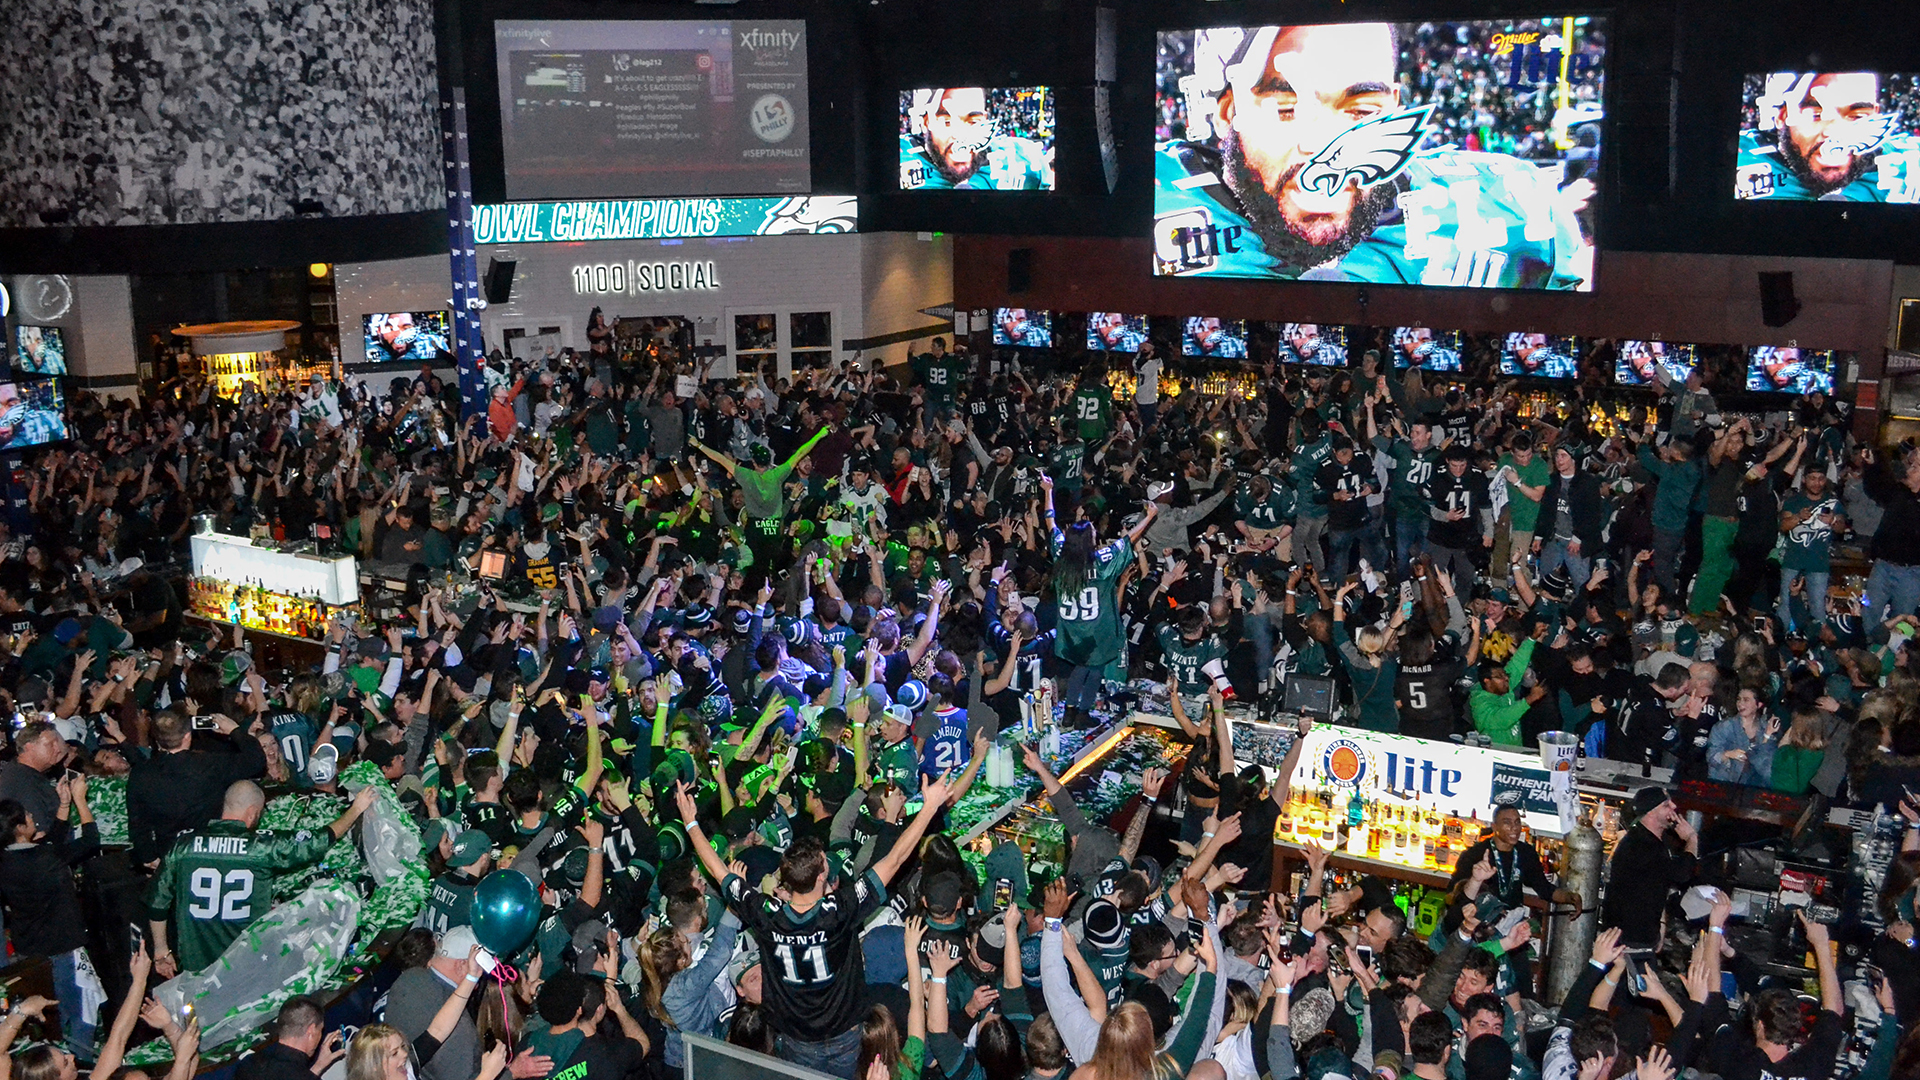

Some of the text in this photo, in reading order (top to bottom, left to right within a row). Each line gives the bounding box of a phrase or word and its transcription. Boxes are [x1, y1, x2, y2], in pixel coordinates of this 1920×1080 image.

[740, 28, 800, 50] xfinity
[1491, 32, 1540, 55] Miller
[760, 116, 788, 134] PHILLY
[549, 198, 723, 241] CHAMPIONS
[1174, 224, 1242, 269] Lite
[571, 261, 721, 295] 1100 SOCIAL
[929, 367, 947, 385] 92
[1447, 426, 1471, 447] 25
[1310, 442, 1332, 461] WENTZ
[1065, 456, 1084, 478] 20
[1406, 458, 1432, 483] 20
[1445, 490, 1471, 519] 11
[763, 527, 777, 535] FLY
[526, 565, 557, 589] 55
[818, 631, 846, 643] ENTZ
[1171, 651, 1198, 666] WENTZ
[1008, 658, 1042, 692] 11
[1170, 662, 1198, 684] 11
[1409, 681, 1427, 709] 5
[934, 740, 962, 768] 21
[1557, 747, 1576, 758] Lite
[1382, 751, 1462, 801] Lite
[478, 807, 497, 822] 11
[193, 836, 248, 855] R.WHITE
[602, 827, 637, 873] 11
[189, 867, 254, 920] 92
[432, 884, 458, 907] WENTZ
[771, 930, 828, 945] WENTZ
[774, 944, 835, 983] 11
